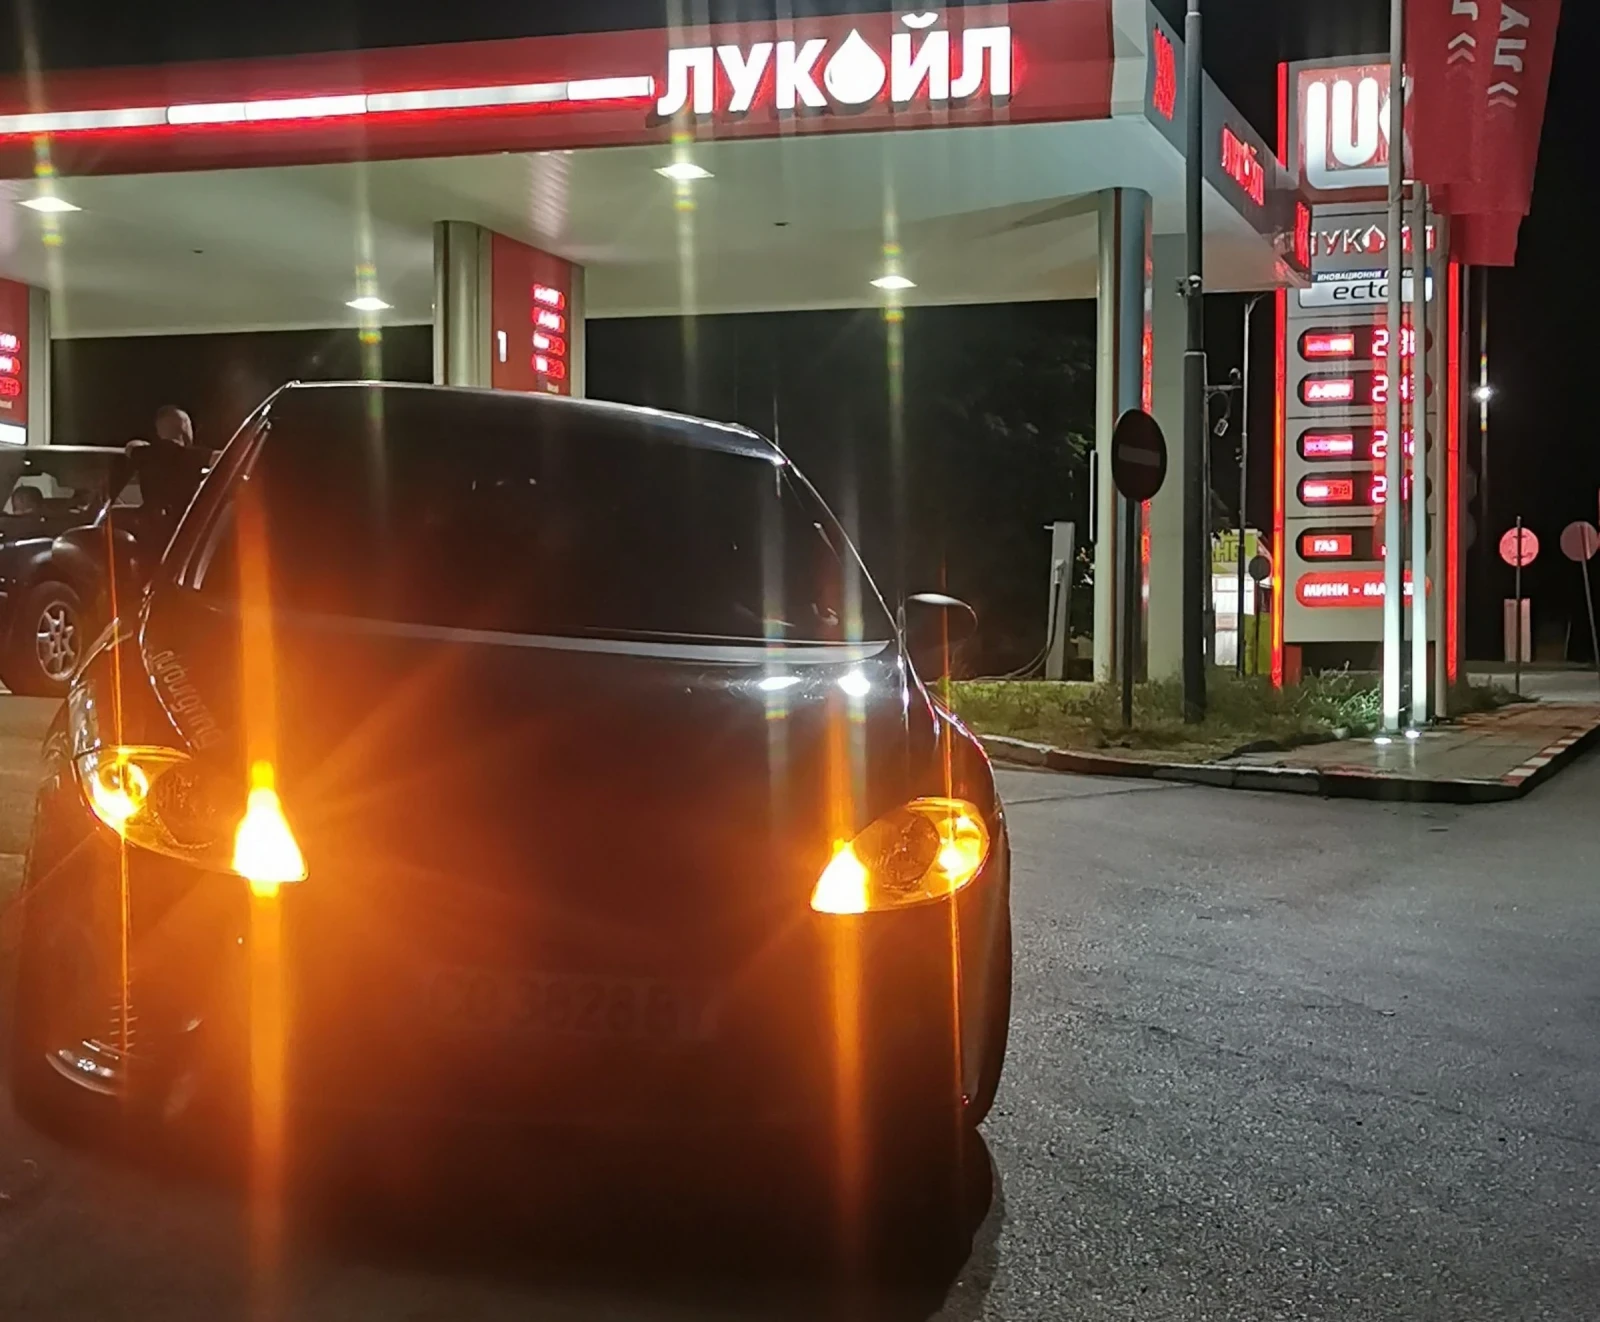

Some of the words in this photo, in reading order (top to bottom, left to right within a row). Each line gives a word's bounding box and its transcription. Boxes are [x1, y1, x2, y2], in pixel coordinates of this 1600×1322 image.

[657, 12, 1012, 116] ЛУКОЙЛ
[1314, 540, 1339, 552] ГАЗ
[1303, 582, 1349, 598] МИНИ
